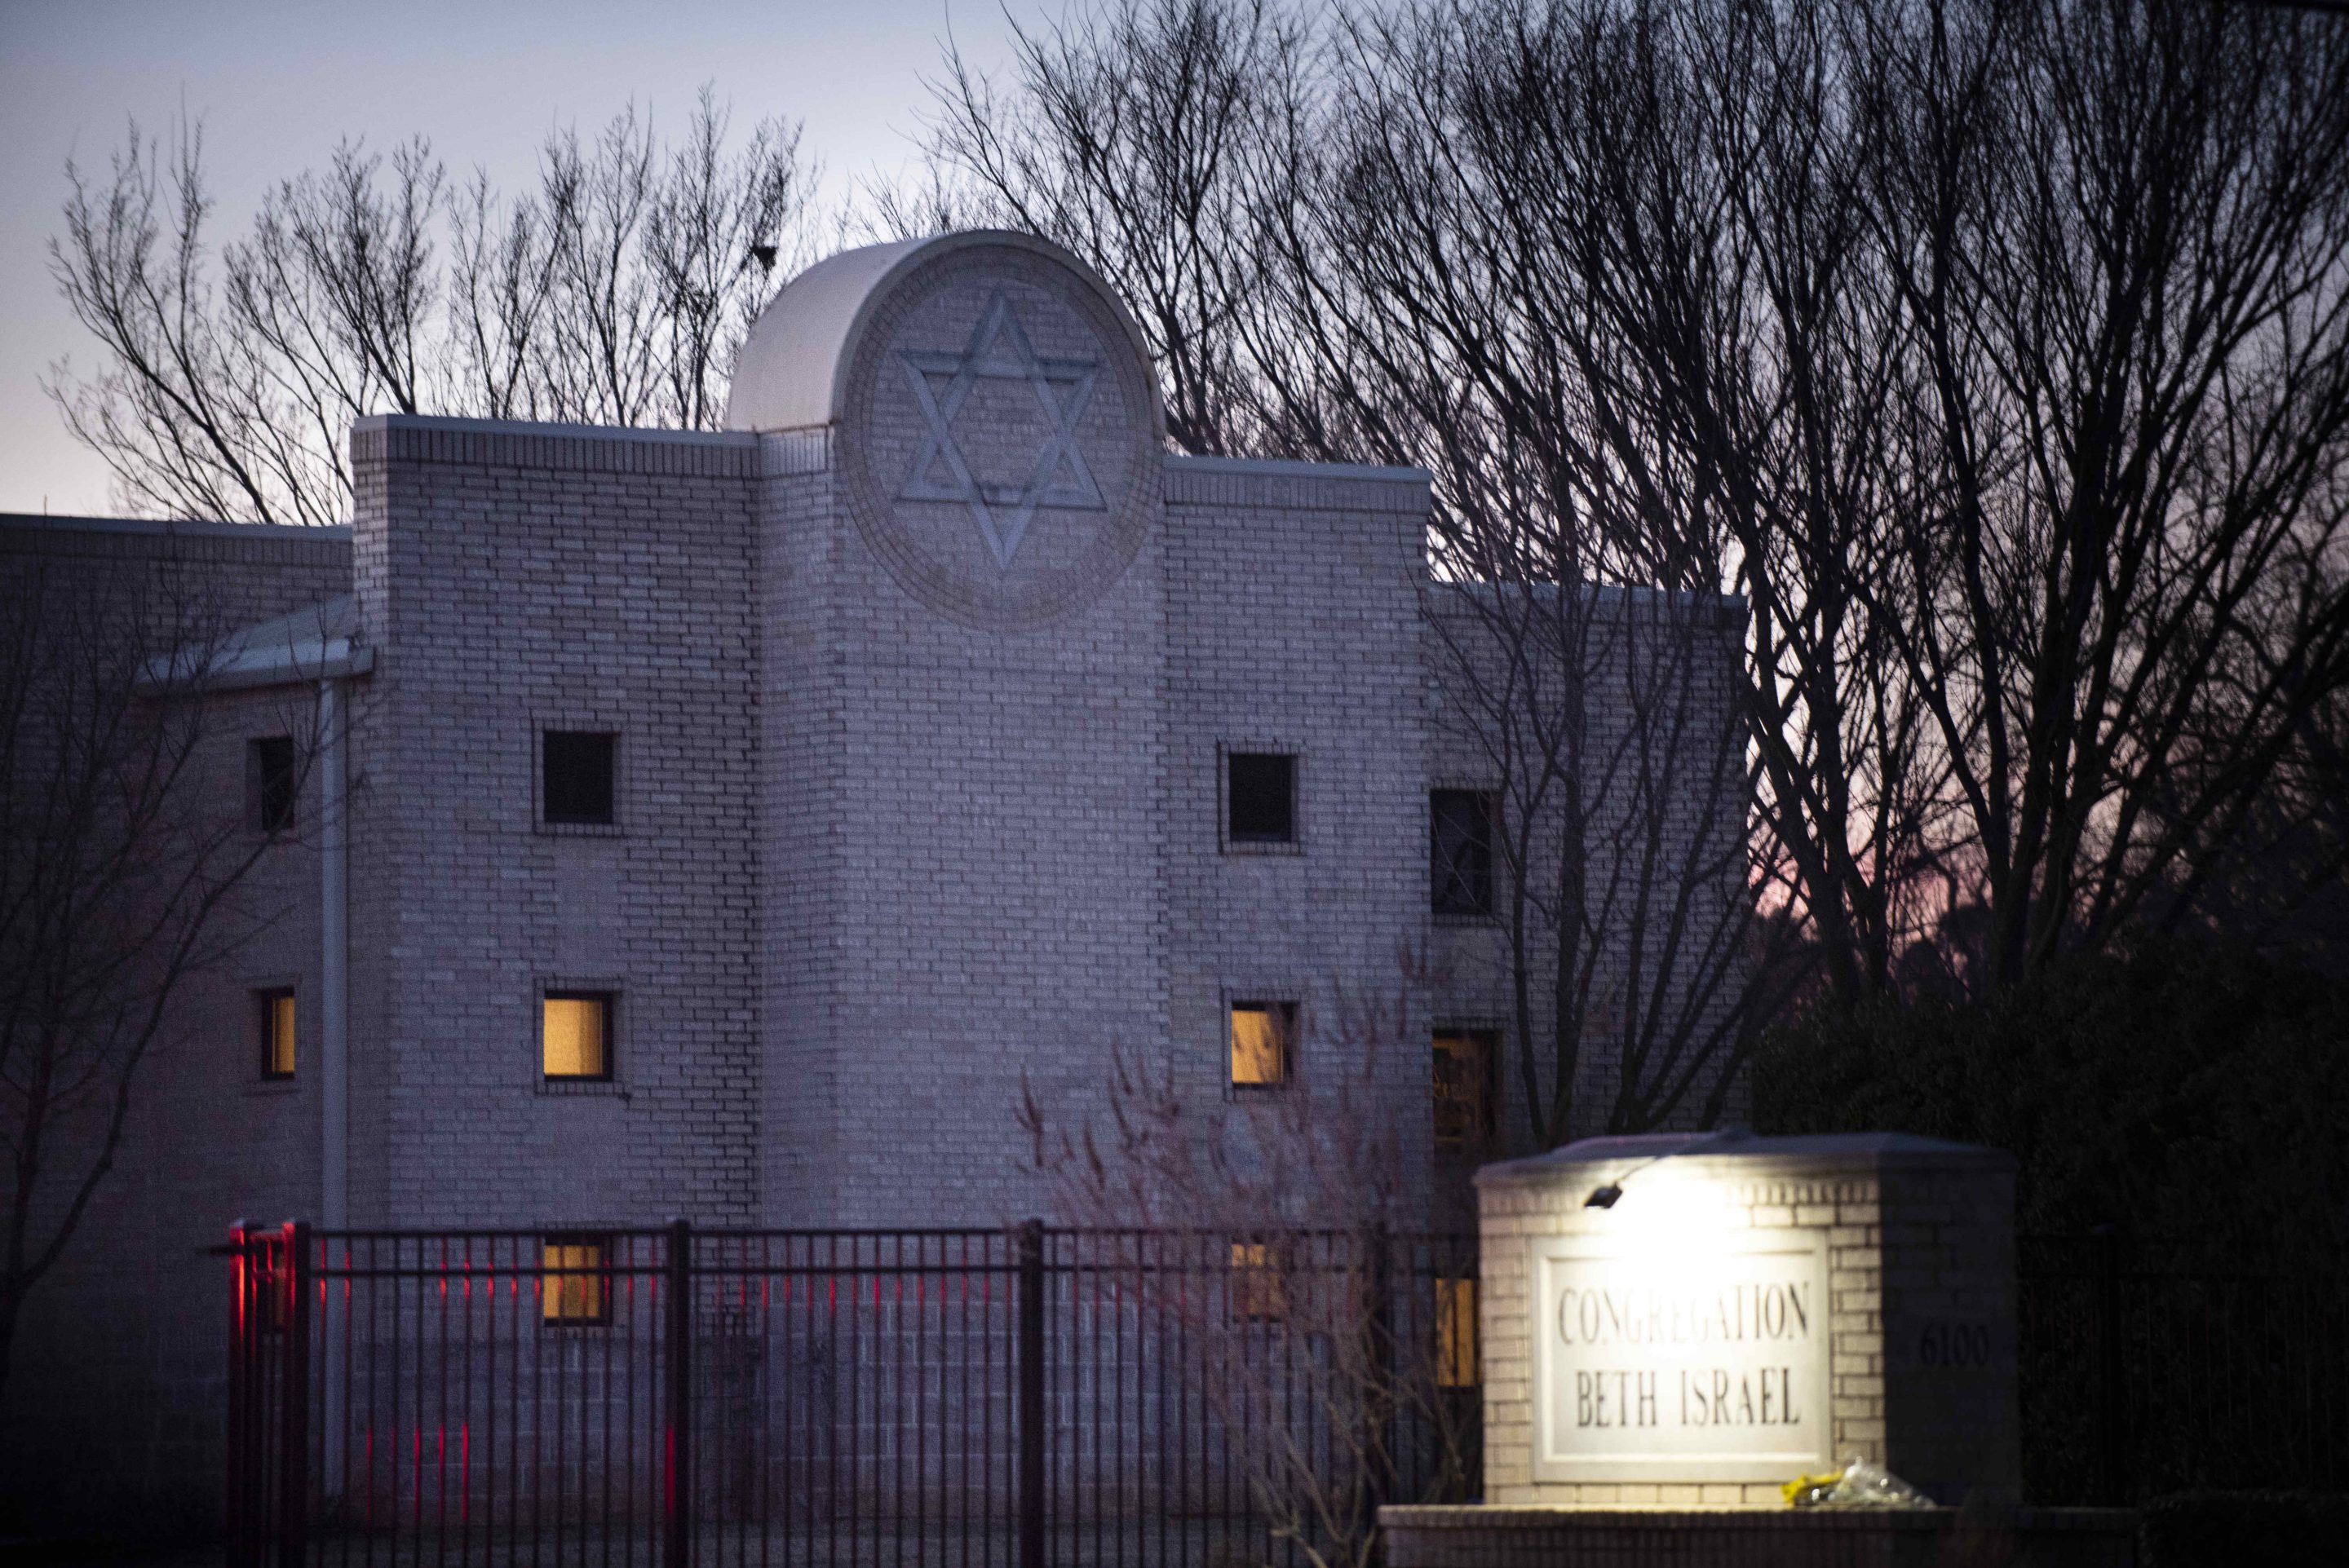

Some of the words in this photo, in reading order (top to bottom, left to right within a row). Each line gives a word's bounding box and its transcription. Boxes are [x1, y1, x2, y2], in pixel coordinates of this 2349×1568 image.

[1559, 1281, 1810, 1345] CONGREGATION
[1919, 1323, 1989, 1367] 6100
[1577, 1370, 1657, 1428] BETH
[1681, 1367, 1801, 1427] ISRAEL
